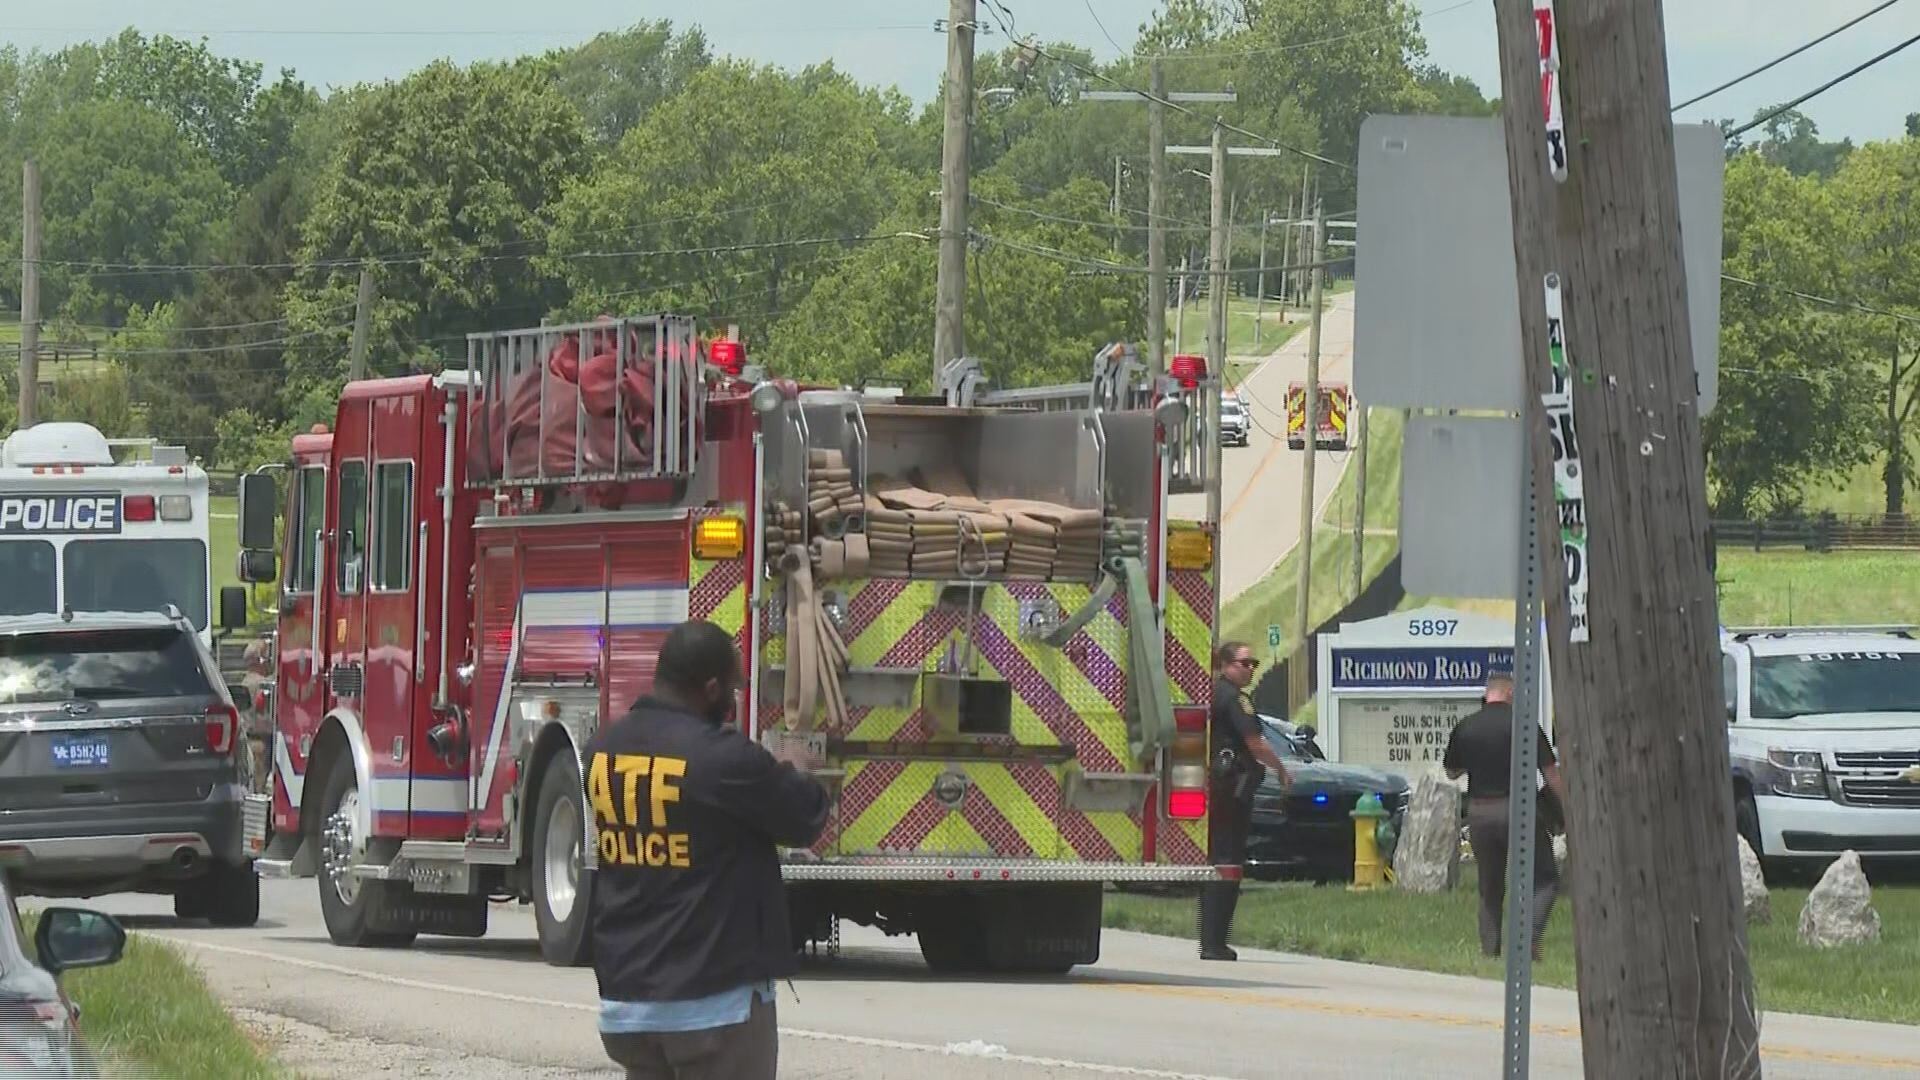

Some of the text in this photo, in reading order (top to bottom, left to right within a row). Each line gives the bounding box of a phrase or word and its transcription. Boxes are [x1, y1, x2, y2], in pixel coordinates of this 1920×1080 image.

[0, 496, 116, 529] POLICE
[1409, 619, 1459, 636] 5897
[1340, 656, 1482, 680] RICHMOND ROAD
[589, 752, 687, 827] ATF
[598, 830, 691, 868] OLICE
